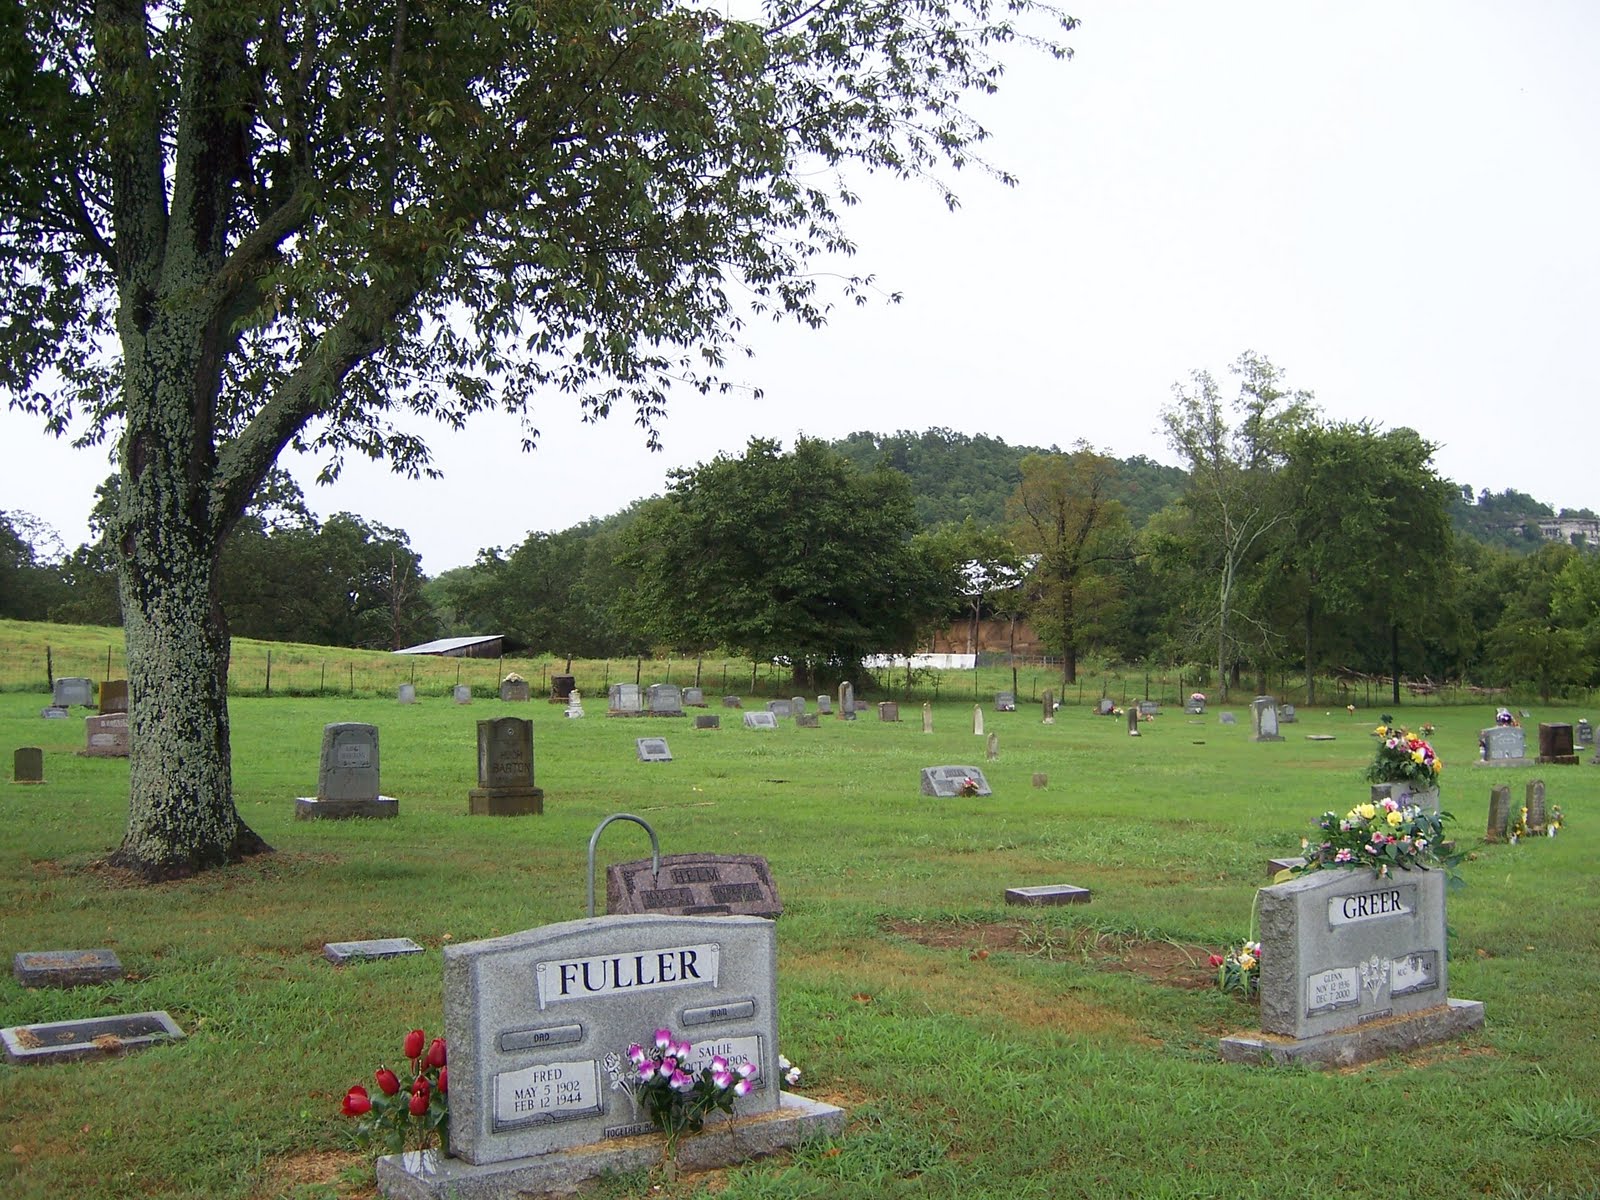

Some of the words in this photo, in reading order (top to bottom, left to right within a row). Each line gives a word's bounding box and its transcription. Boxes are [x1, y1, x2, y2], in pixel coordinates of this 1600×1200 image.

[673, 868, 720, 883] HELM
[1343, 890, 1401, 919] GREER
[559, 950, 701, 995] FULLER
[1323, 972, 1343, 983] GLENN
[1316, 984, 1328, 993] NOV
[1316, 994, 1328, 1003] DEC
[1336, 989, 1351, 1000] 2000
[534, 1033, 550, 1043] DAD
[699, 1043, 732, 1058] SALLIE
[684, 1060, 704, 1071] OCT
[726, 1054, 748, 1067] 1908
[533, 1069, 562, 1083] FRED
[515, 1086, 538, 1100] MAY
[544, 1085, 551, 1096] 5
[556, 1080, 580, 1094] 1902
[515, 1099, 534, 1112] FEB
[540, 1097, 550, 1108] 12
[556, 1092, 582, 1105] 1944
[607, 1125, 642, 1138] TOGETHER
